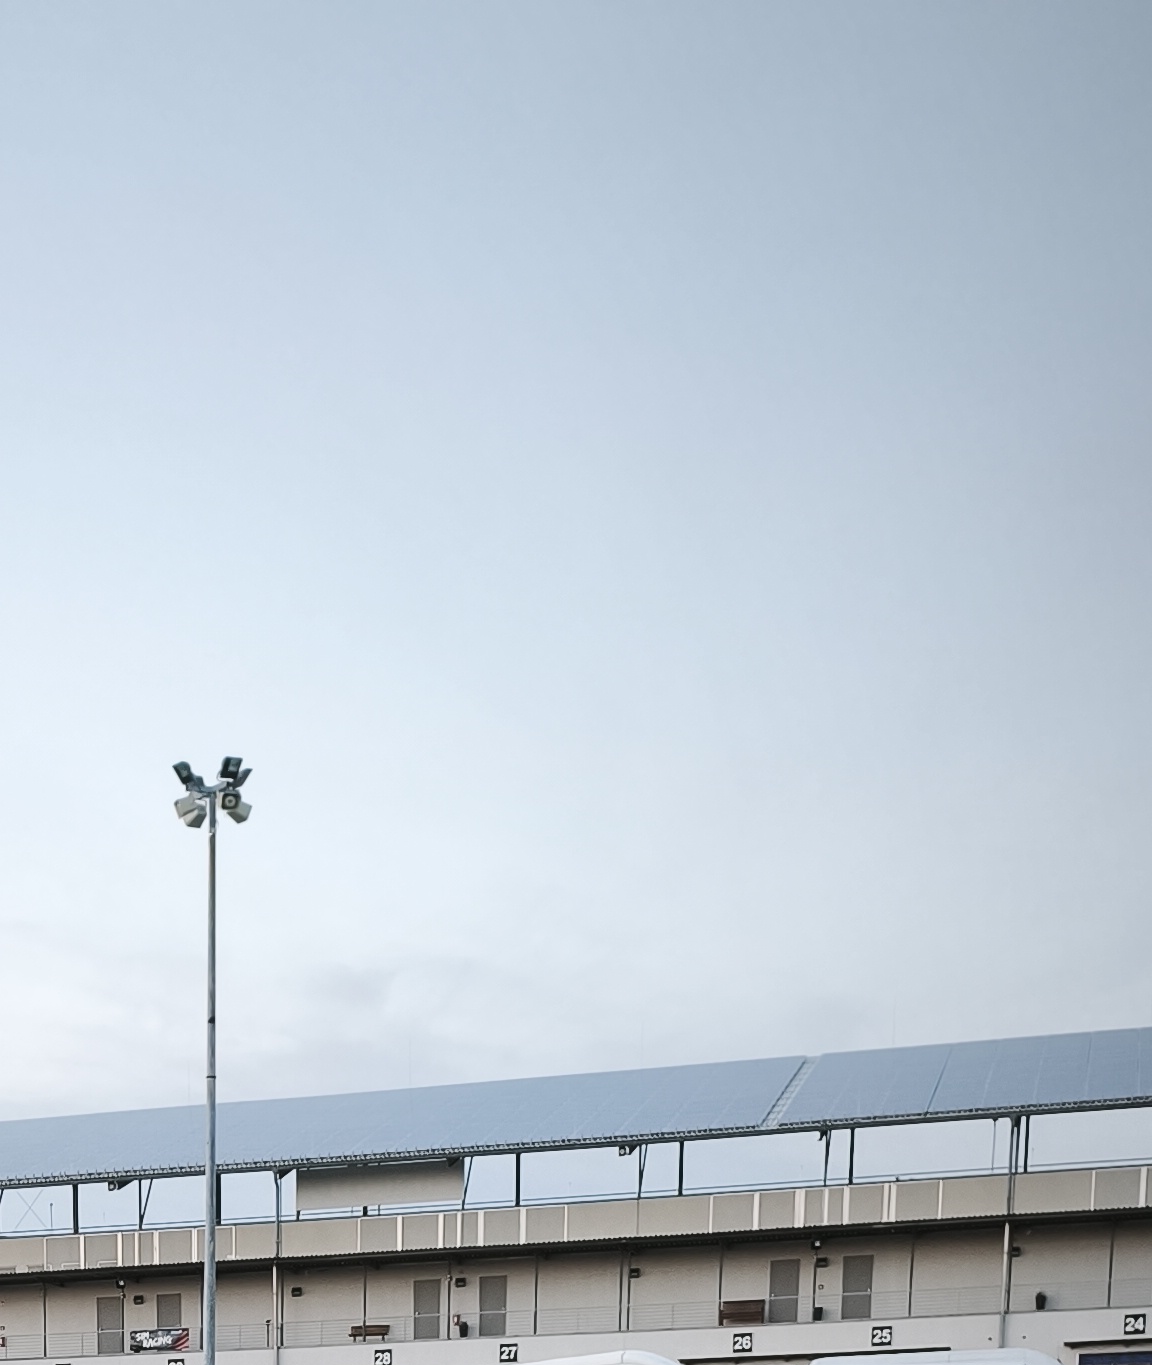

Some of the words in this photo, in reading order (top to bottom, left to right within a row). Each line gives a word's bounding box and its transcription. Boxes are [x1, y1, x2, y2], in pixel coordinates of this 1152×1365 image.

[1125, 1316, 1144, 1332] 24
[733, 1336, 751, 1350] 26
[872, 1329, 891, 1343] 25
[374, 1352, 391, 1365] 28
[500, 1346, 517, 1359] 27
